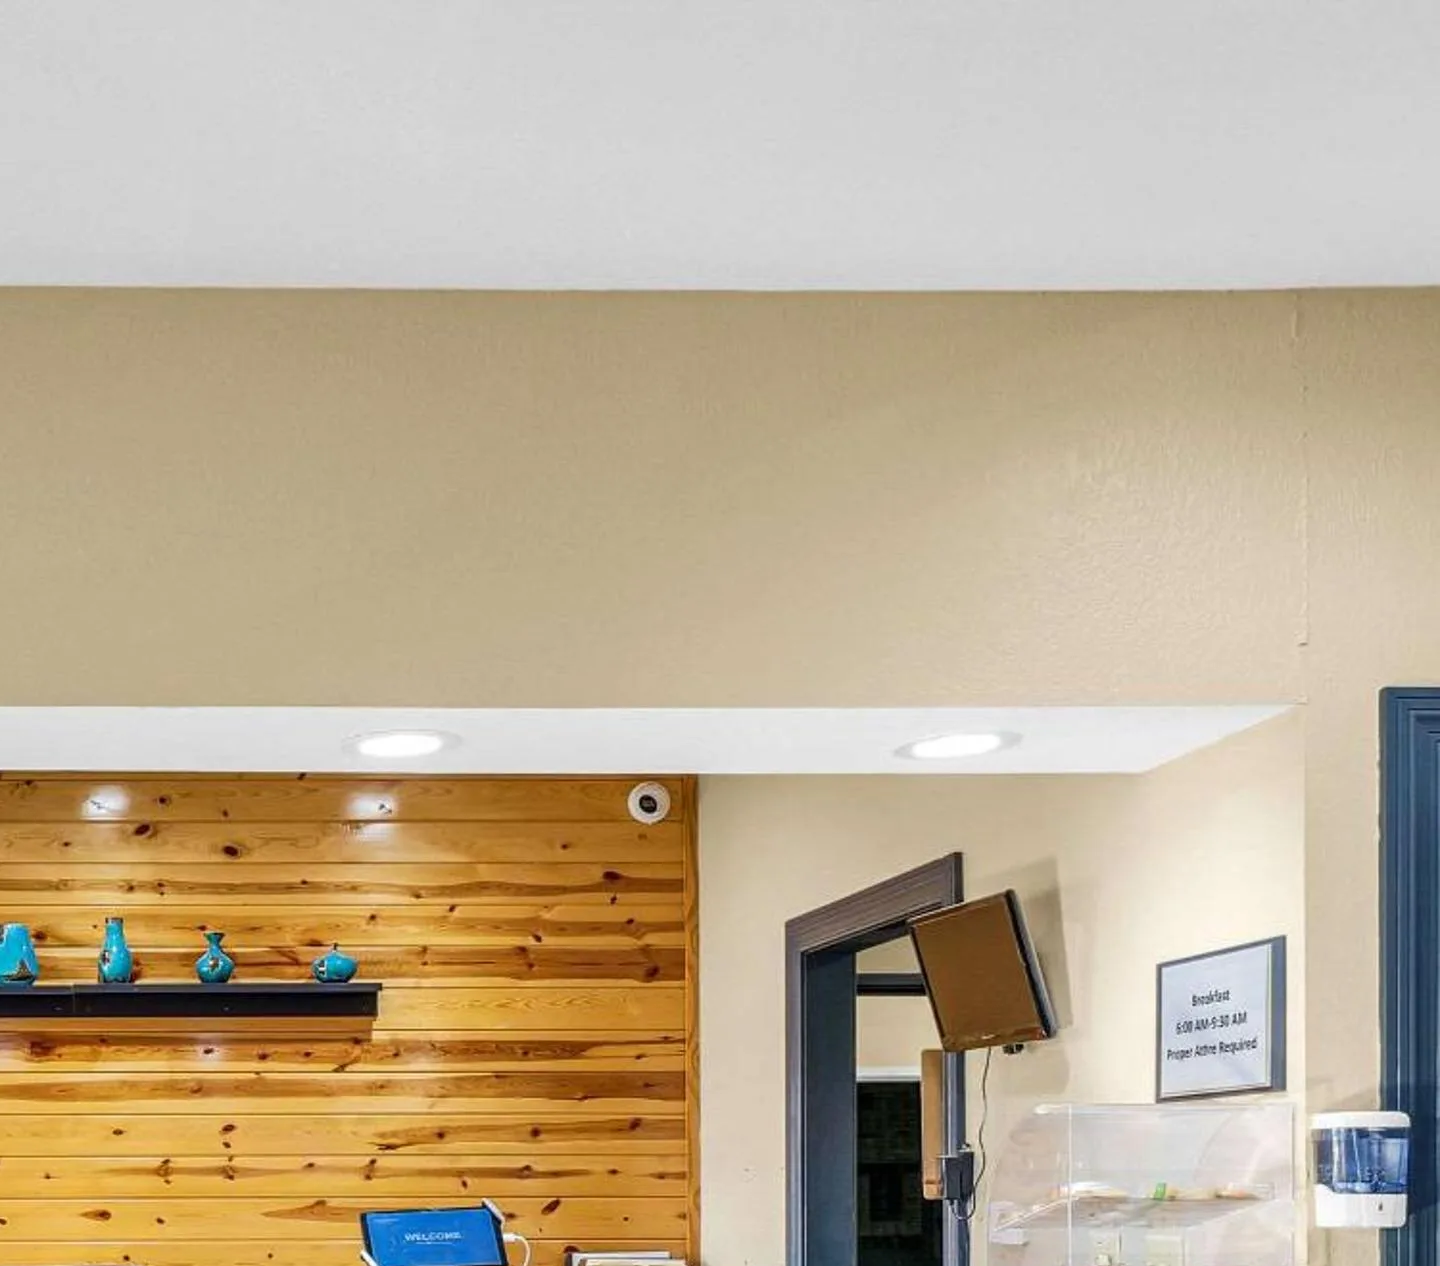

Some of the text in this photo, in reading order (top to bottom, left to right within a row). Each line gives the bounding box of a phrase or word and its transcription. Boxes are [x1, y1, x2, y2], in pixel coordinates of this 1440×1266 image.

[1191, 989, 1230, 1007] Breakfast
[1232, 1011, 1248, 1025] AM
[1219, 1037, 1258, 1055] Required
